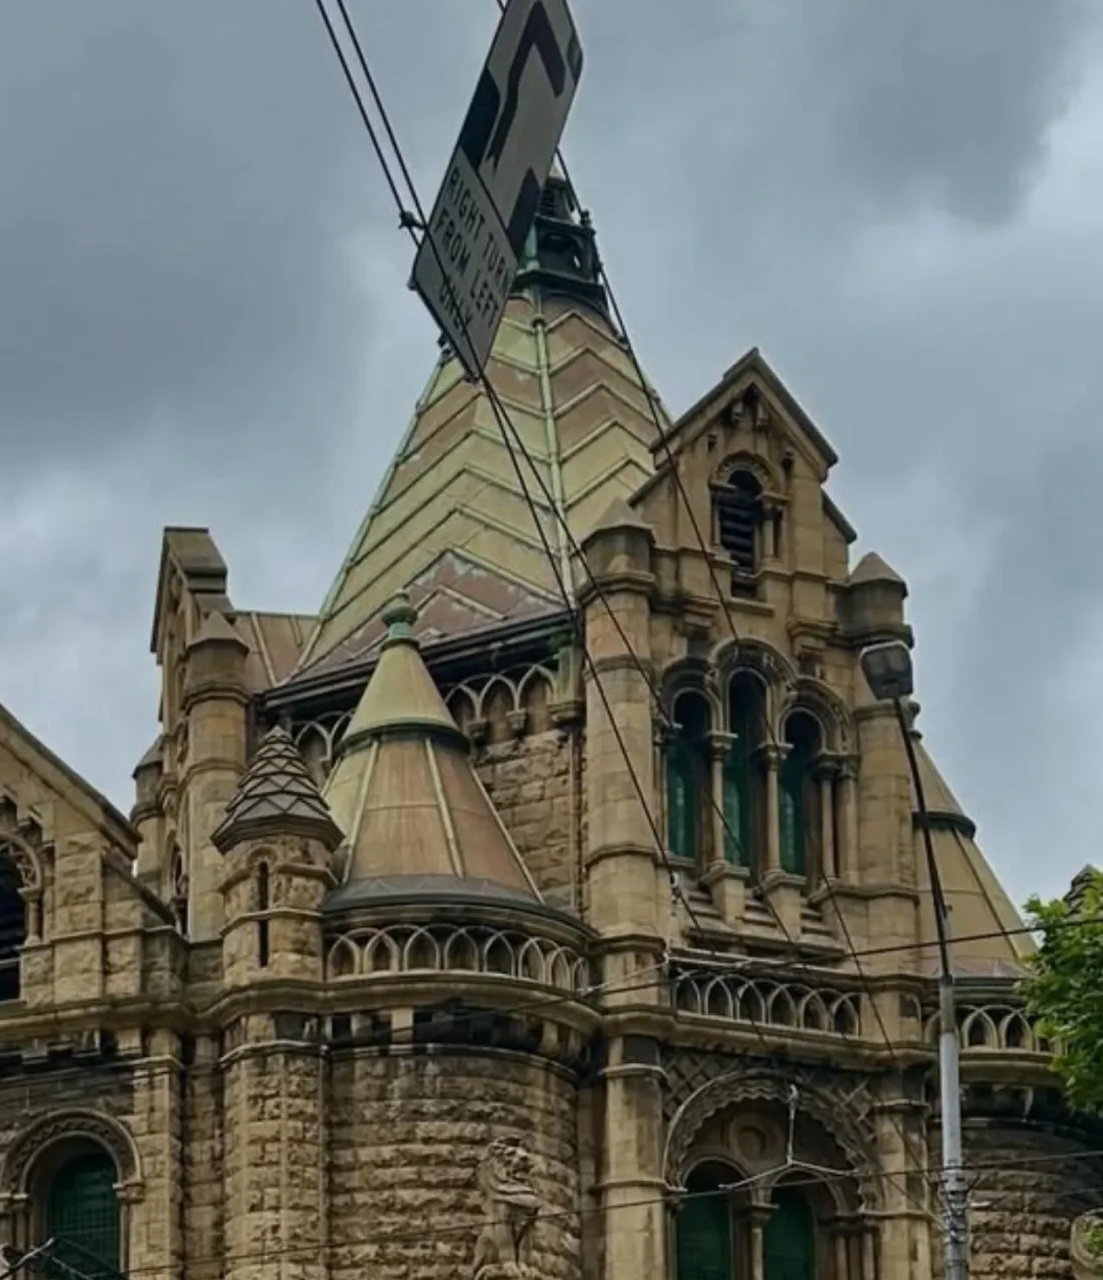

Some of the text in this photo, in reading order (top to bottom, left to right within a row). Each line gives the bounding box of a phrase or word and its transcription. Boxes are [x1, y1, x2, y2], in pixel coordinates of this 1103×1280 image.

[434, 206, 500, 329] FROM LEFT
[448, 165, 513, 297] RIGHT TURN
